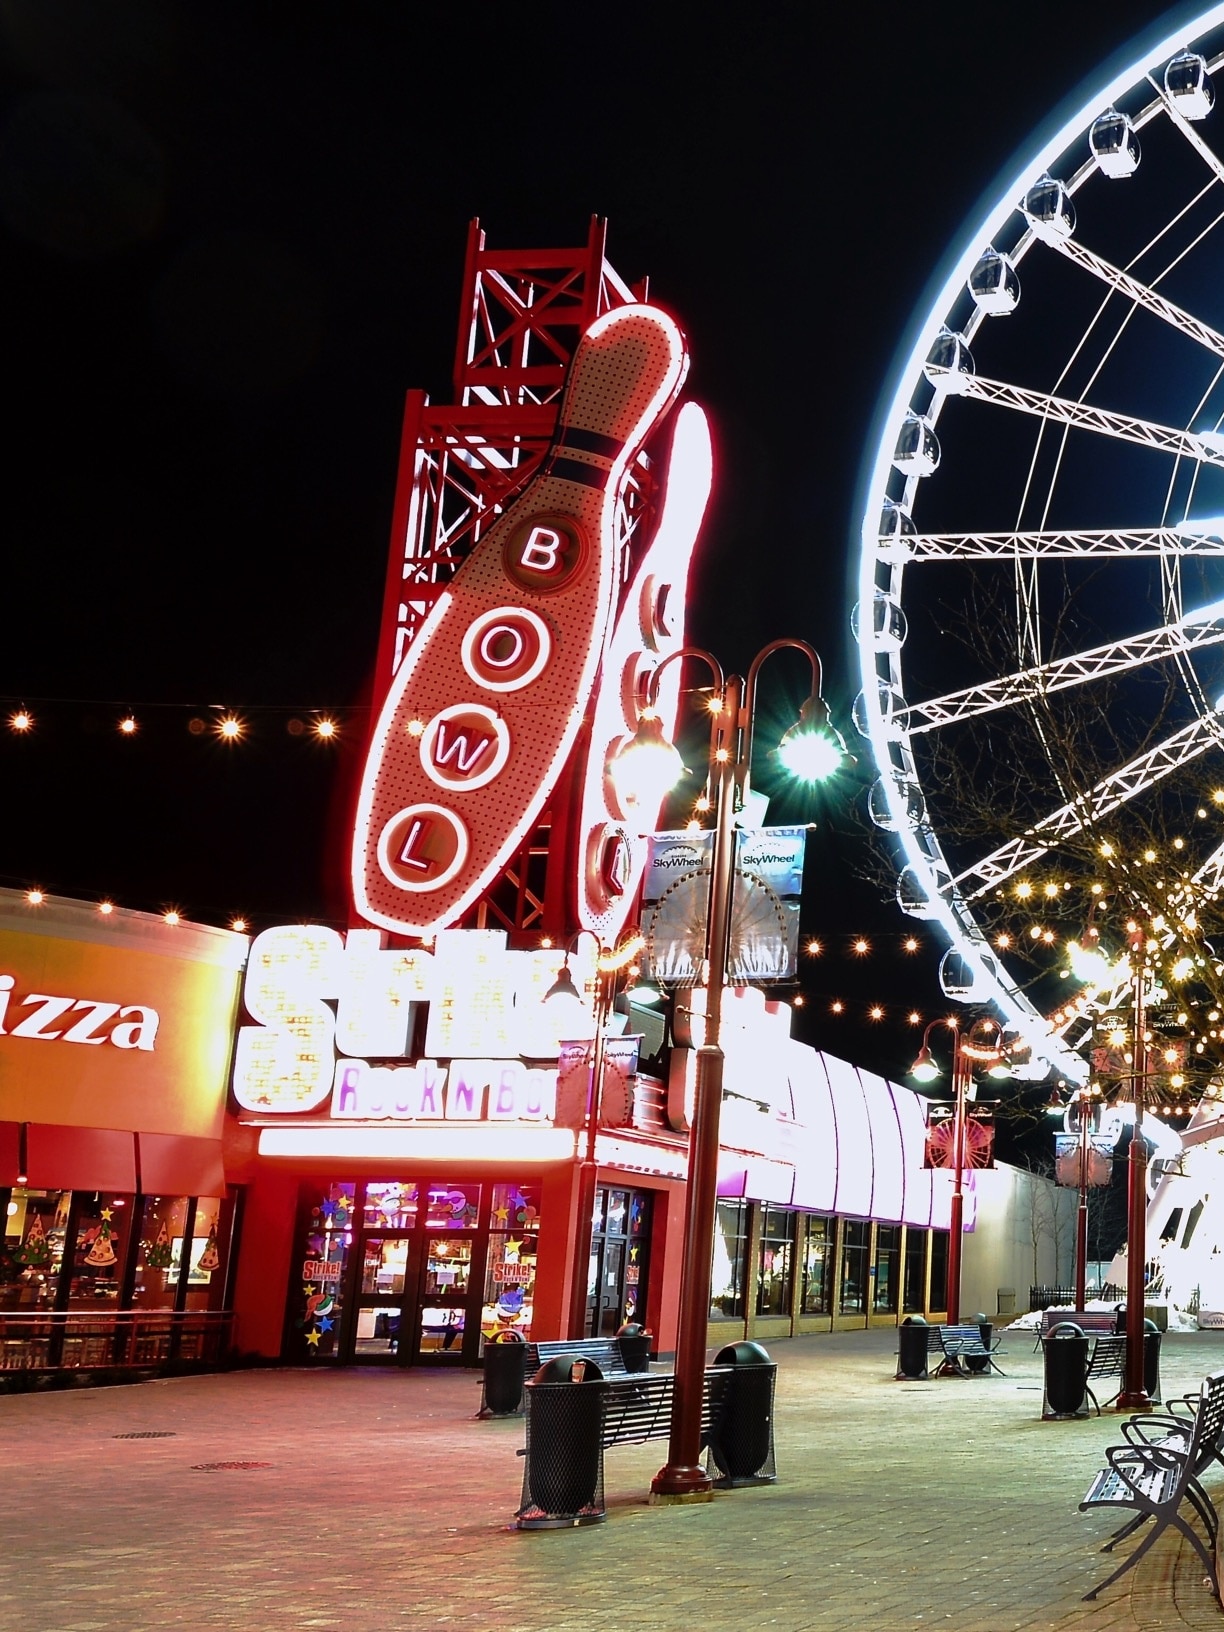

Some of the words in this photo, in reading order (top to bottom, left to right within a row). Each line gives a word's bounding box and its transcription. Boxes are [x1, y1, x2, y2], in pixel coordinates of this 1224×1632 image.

[395, 522, 566, 873] BOWL
[653, 856, 704, 869] SkyWheel
[743, 854, 795, 866] SkyWheel
[0, 974, 160, 1052] izza
